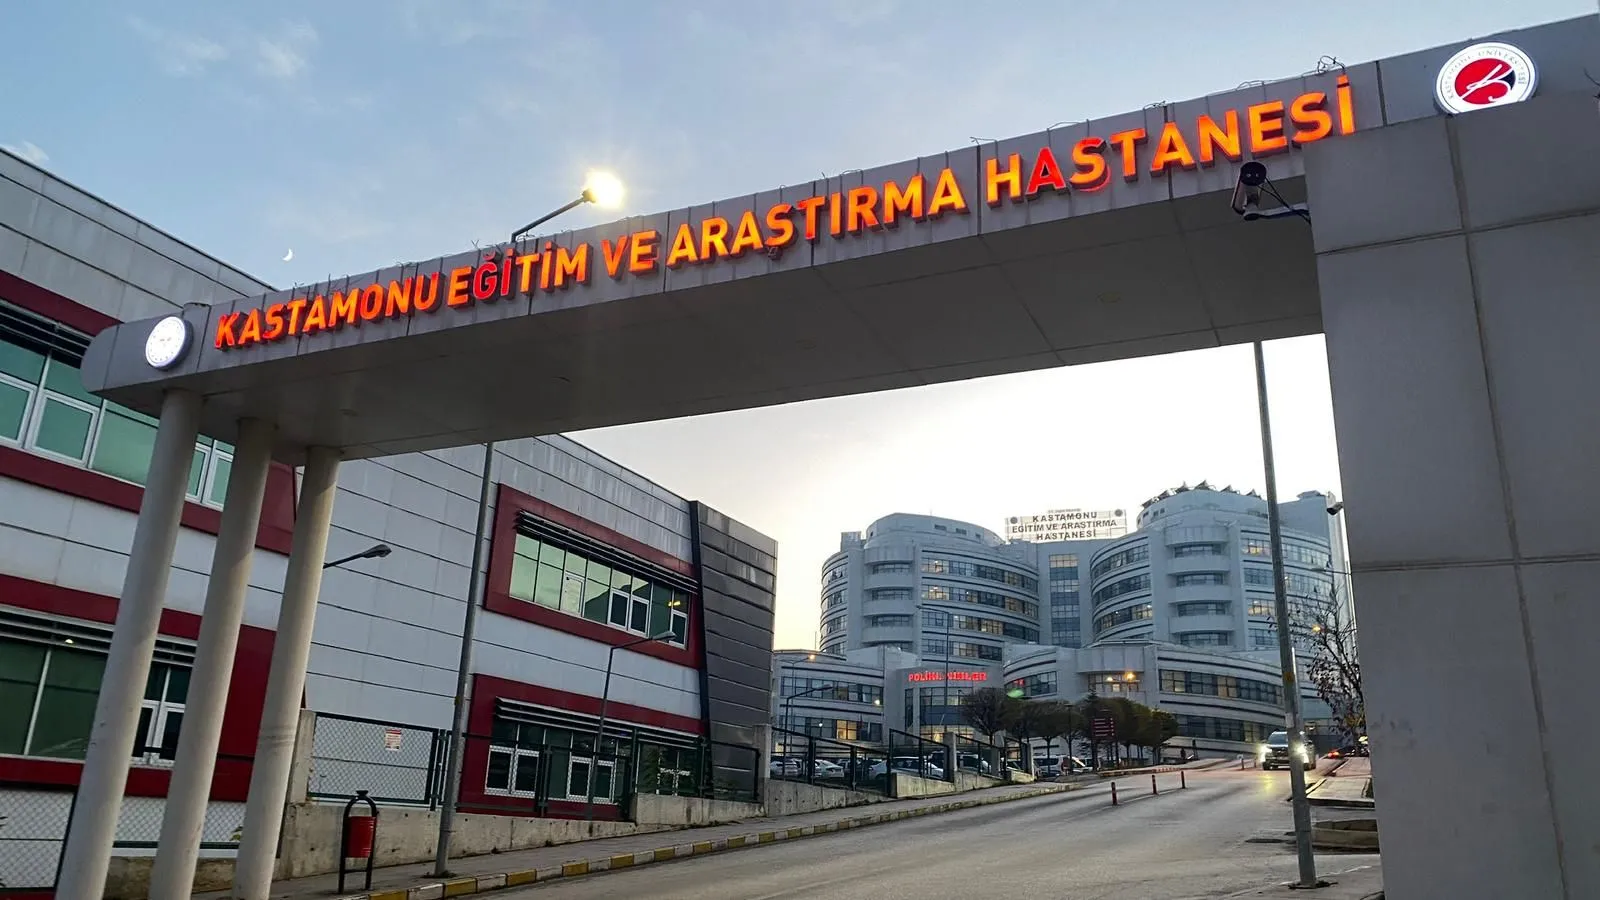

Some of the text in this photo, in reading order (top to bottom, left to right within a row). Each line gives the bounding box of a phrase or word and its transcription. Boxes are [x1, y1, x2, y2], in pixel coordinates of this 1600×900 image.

[214, 271, 440, 349] KASTAMONU
[446, 240, 589, 307] EĞİTİM
[600, 230, 658, 276] VE
[665, 168, 966, 265] ARAŞTIRMA
[984, 75, 1356, 204] HASTANESİ
[1033, 511, 1097, 522] KASTAMONU
[1046, 523, 1058, 531] VE
[909, 671, 987, 681] POLİKLNİKLER
